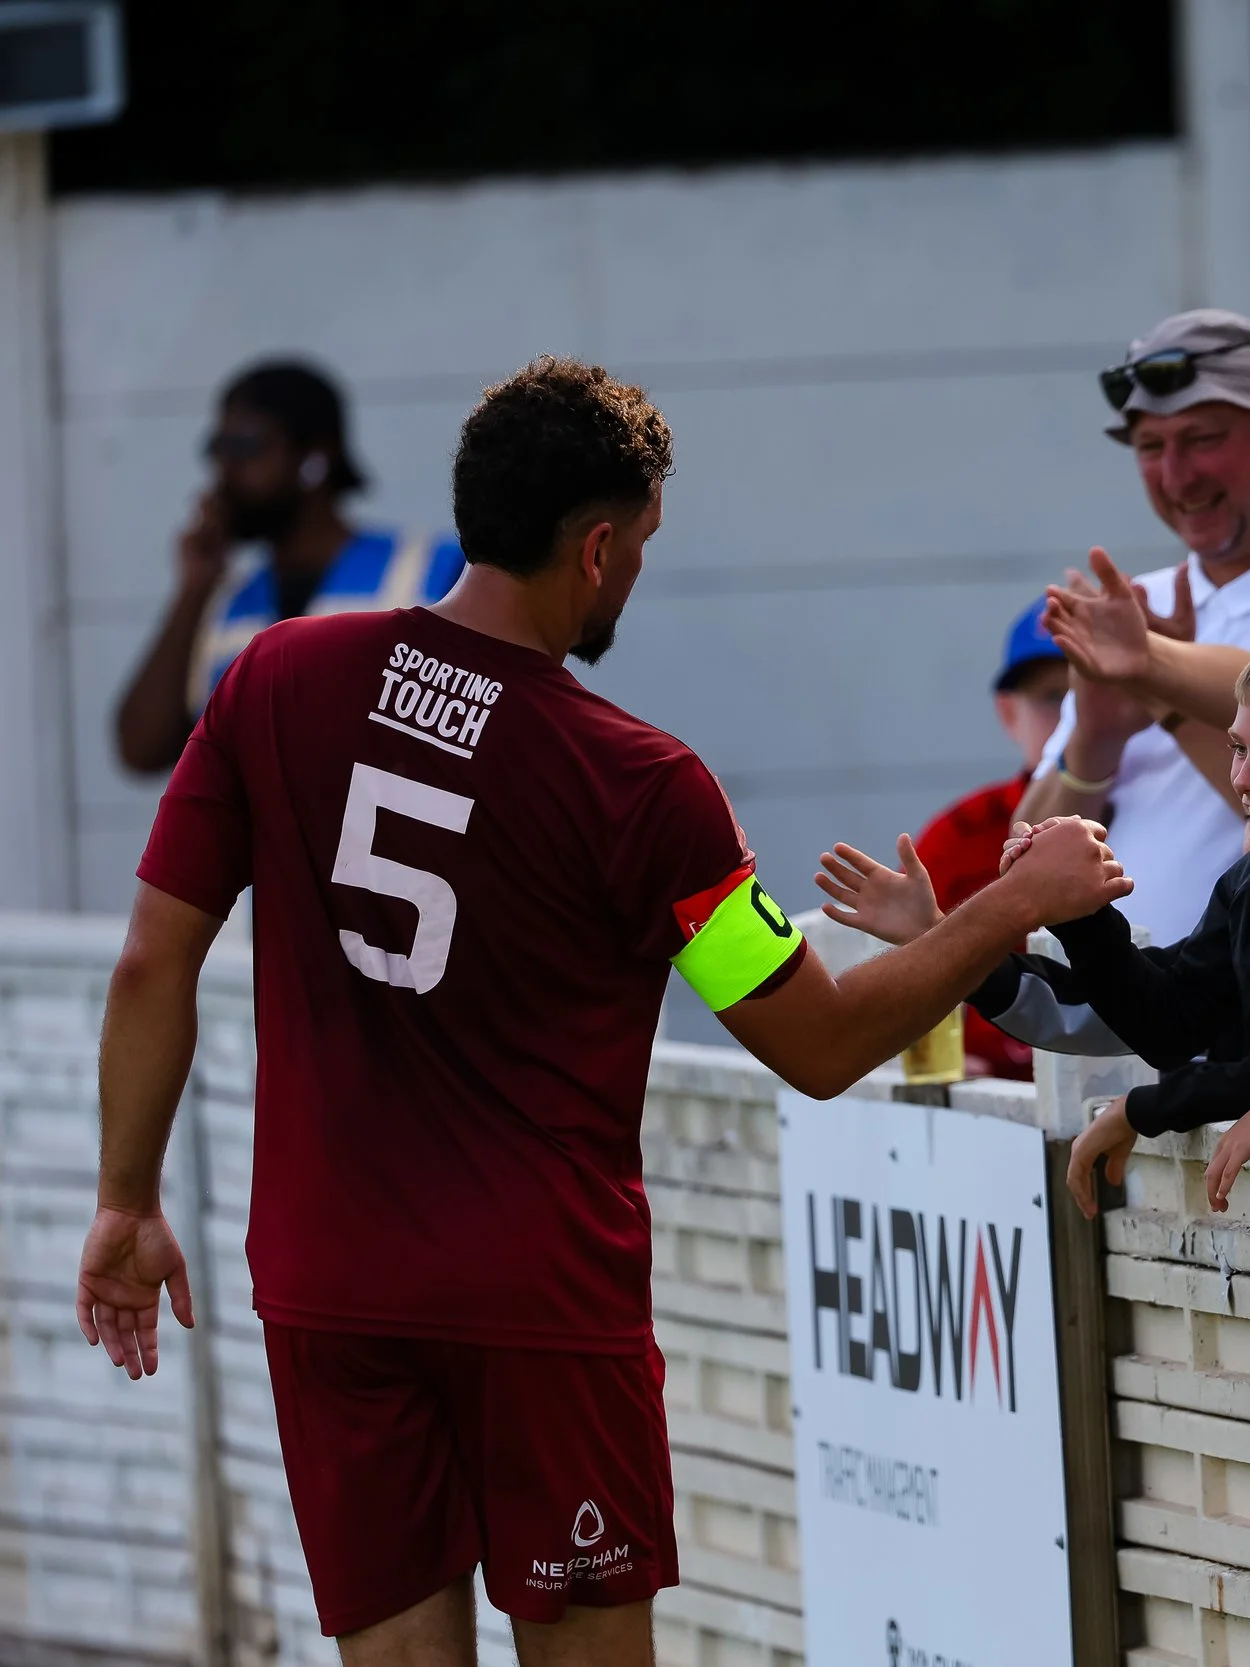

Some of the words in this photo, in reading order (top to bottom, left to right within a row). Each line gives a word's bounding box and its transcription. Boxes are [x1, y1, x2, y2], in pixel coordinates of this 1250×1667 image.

[377, 668, 491, 747] TOUCH
[389, 642, 503, 706] SPORTING
[331, 761, 475, 995] 5
[807, 1190, 1023, 1414] HEADWAY
[532, 1544, 629, 1577] NEEDHAM
[586, 1562, 633, 1580] SERVICES
